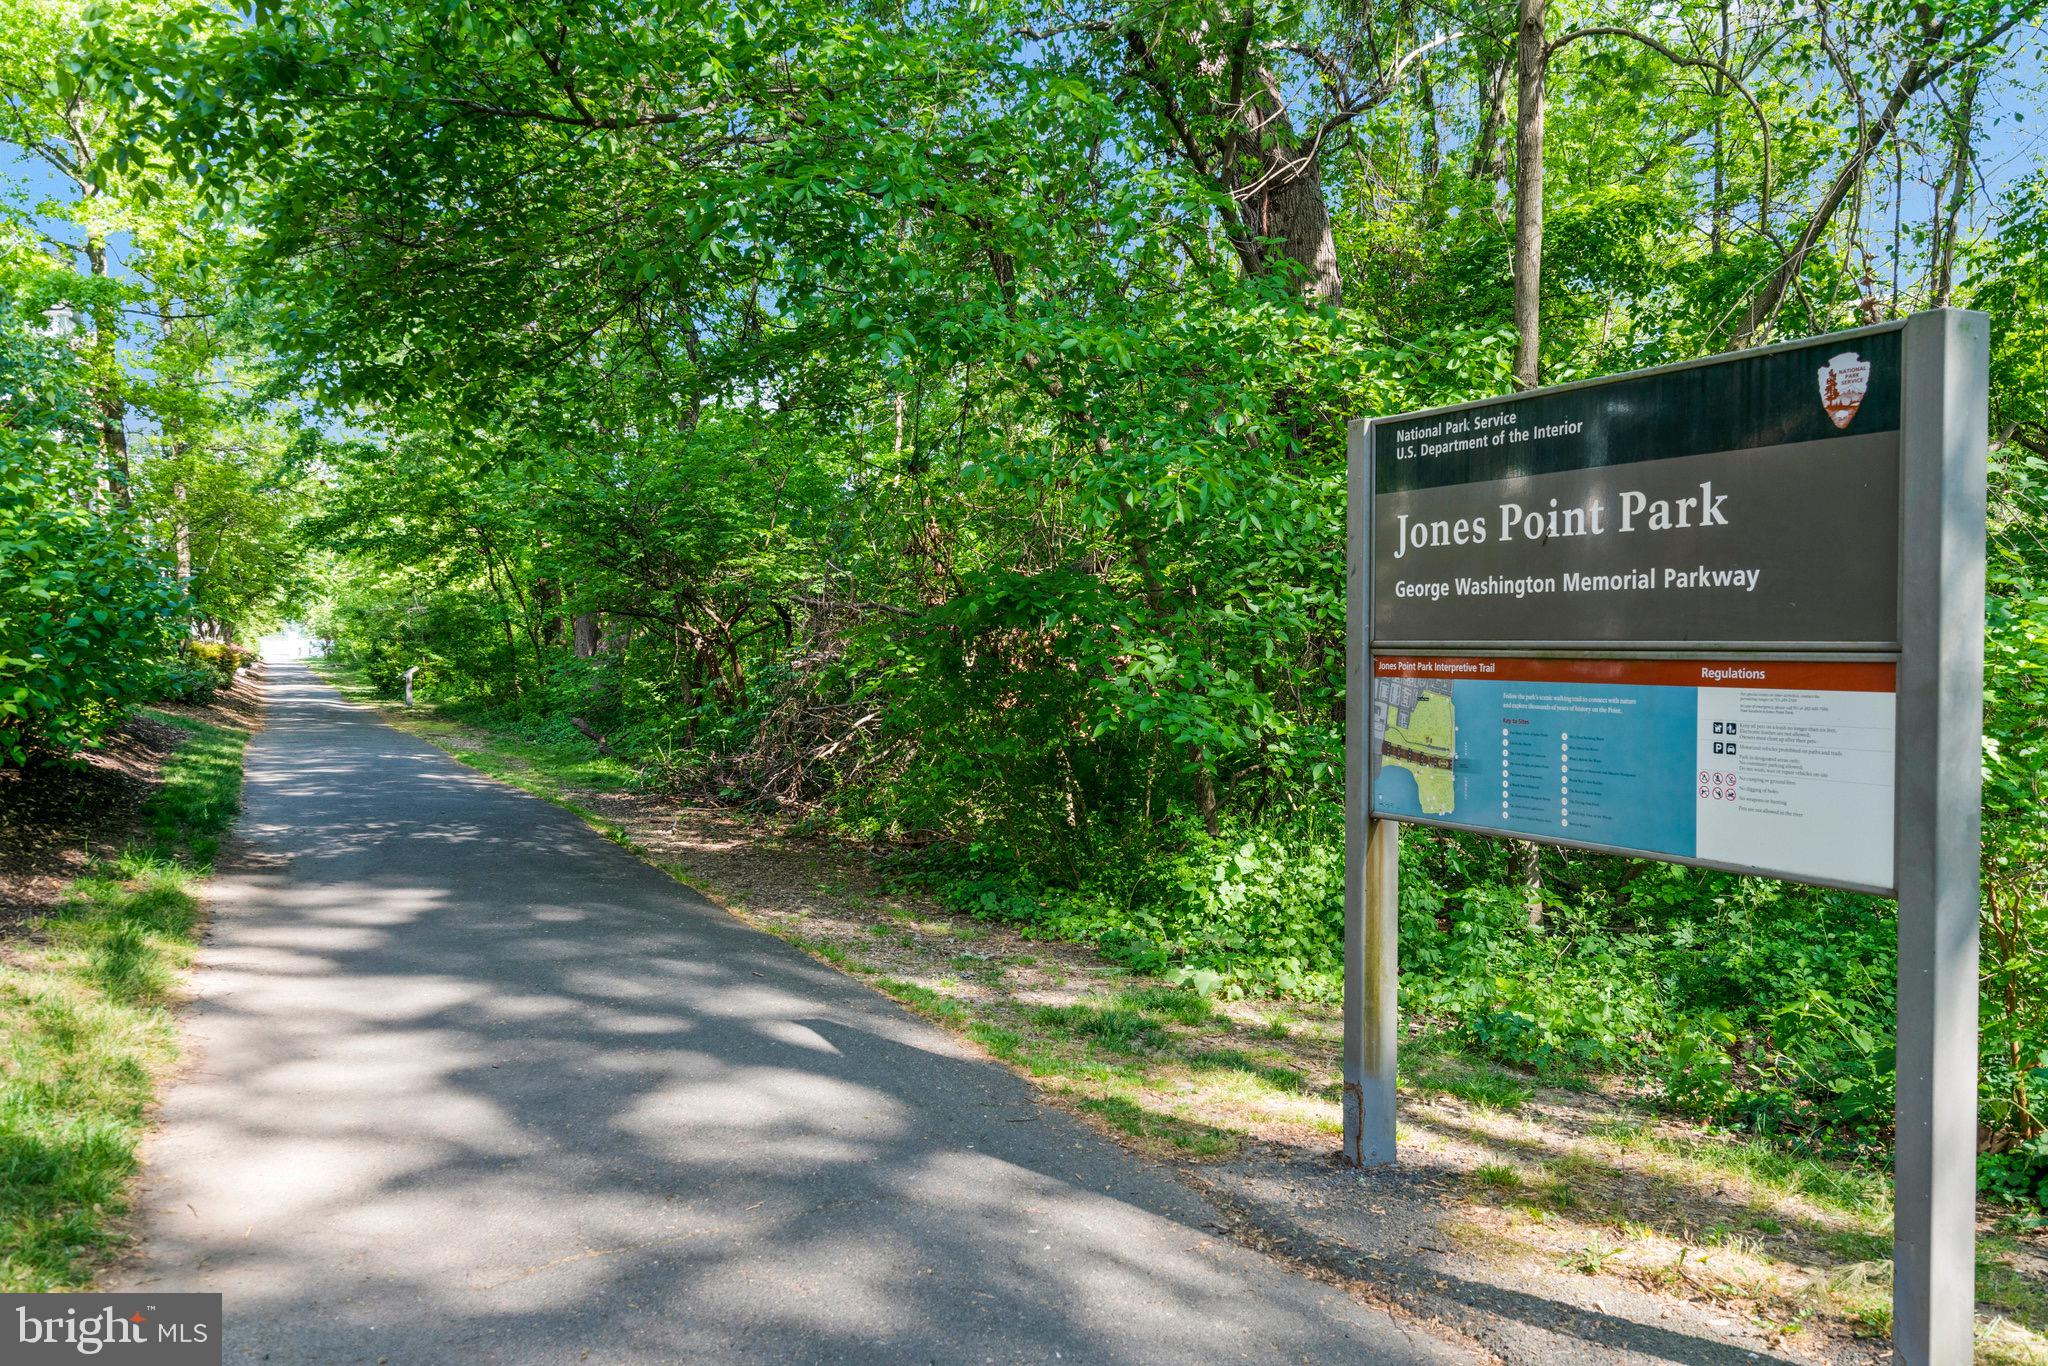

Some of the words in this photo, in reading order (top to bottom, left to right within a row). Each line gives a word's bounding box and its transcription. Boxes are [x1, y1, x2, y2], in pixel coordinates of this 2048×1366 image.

[1839, 366, 1866, 374] NATIONAL
[1397, 423, 1441, 442] National
[1446, 418, 1470, 434] Park
[1475, 412, 1517, 431] Service
[1397, 446, 1416, 459] U.S.
[1419, 437, 1489, 458] Department
[1492, 430, 1506, 446] of
[1509, 429, 1529, 442] the
[1534, 421, 1582, 439] Interior
[1394, 515, 1486, 558] Jones
[1499, 499, 1604, 541] Point
[1619, 481, 1728, 532] Park
[1396, 581, 1449, 601] George
[1455, 576, 1555, 598] Washington
[1564, 568, 1655, 591] Memorial
[1665, 566, 1760, 591] Parkway
[1378, 661, 1397, 670] Jones
[1398, 662, 1416, 671] Point
[1417, 662, 1433, 671] Park
[1434, 662, 1477, 674] Interpretive
[1479, 663, 1496, 673] Trail
[1701, 667, 1766, 681] Regulations
[1716, 744, 1722, 753] P
